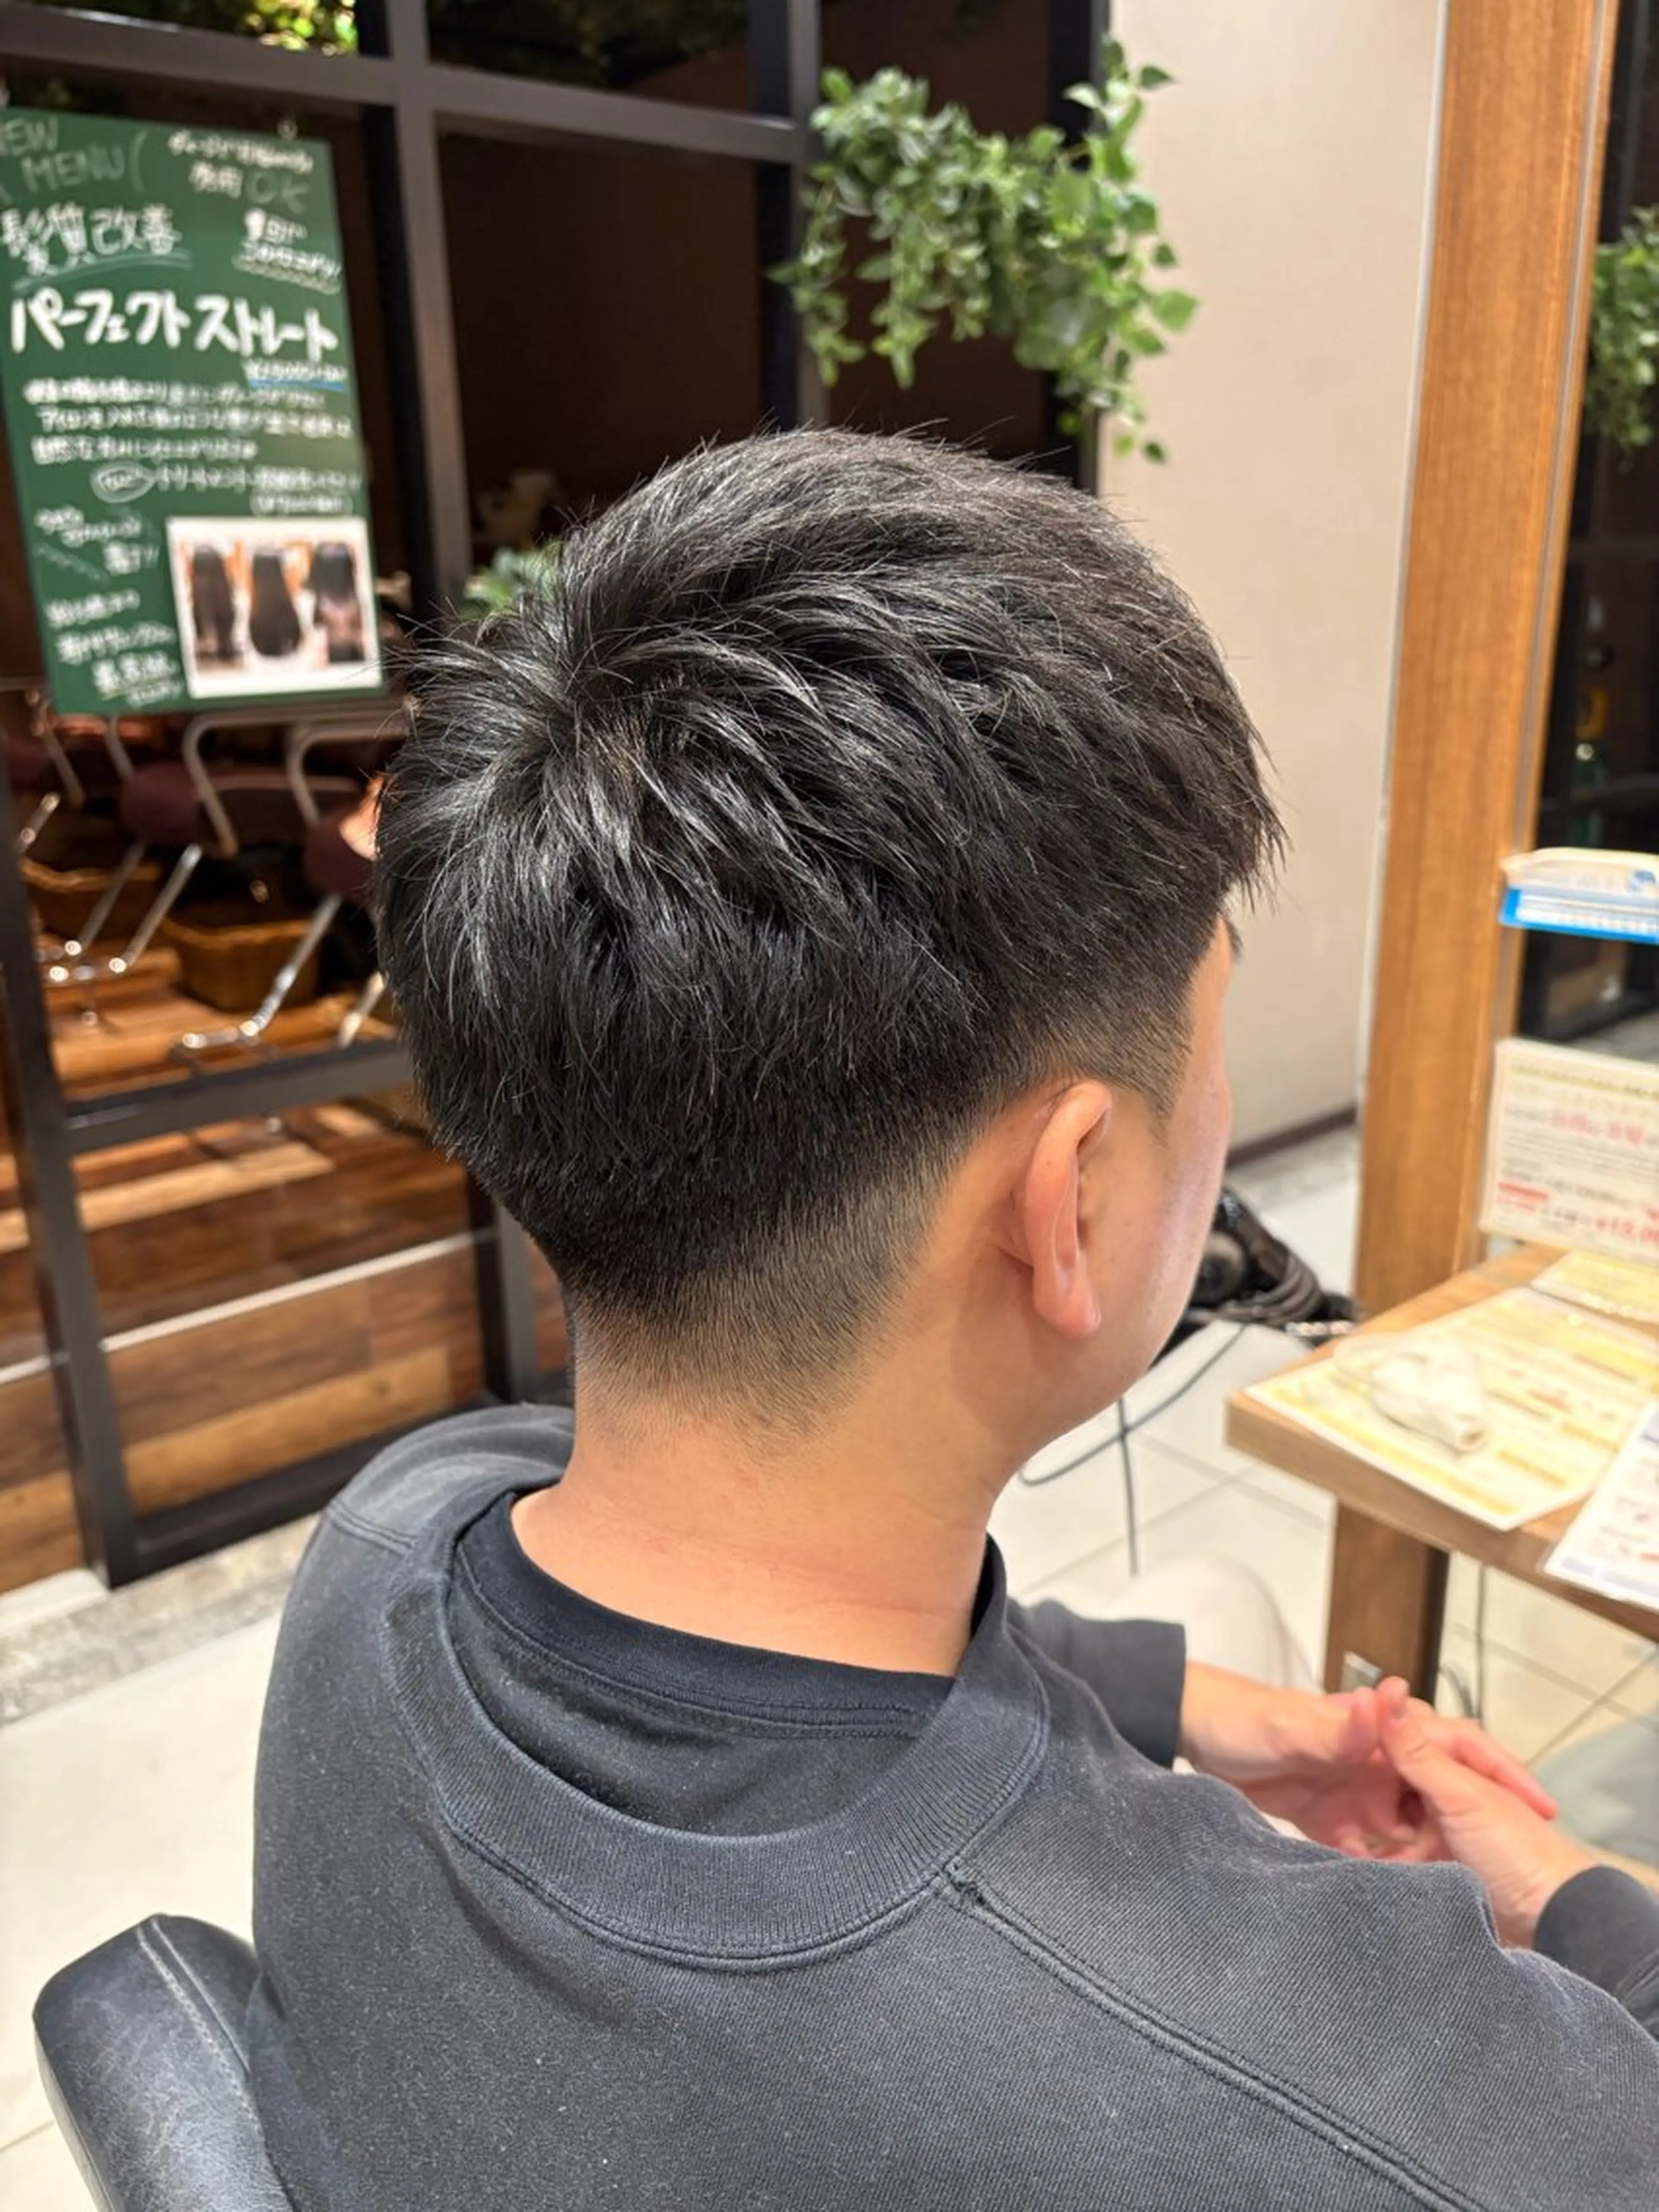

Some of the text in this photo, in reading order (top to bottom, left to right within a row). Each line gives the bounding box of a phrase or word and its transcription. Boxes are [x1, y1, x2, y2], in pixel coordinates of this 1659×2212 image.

[0, 117, 58, 156] EW
[22, 143, 125, 193] MENU
[1, 203, 182, 275] 髪質改善
[11, 287, 339, 362] パーフェクトストレート
